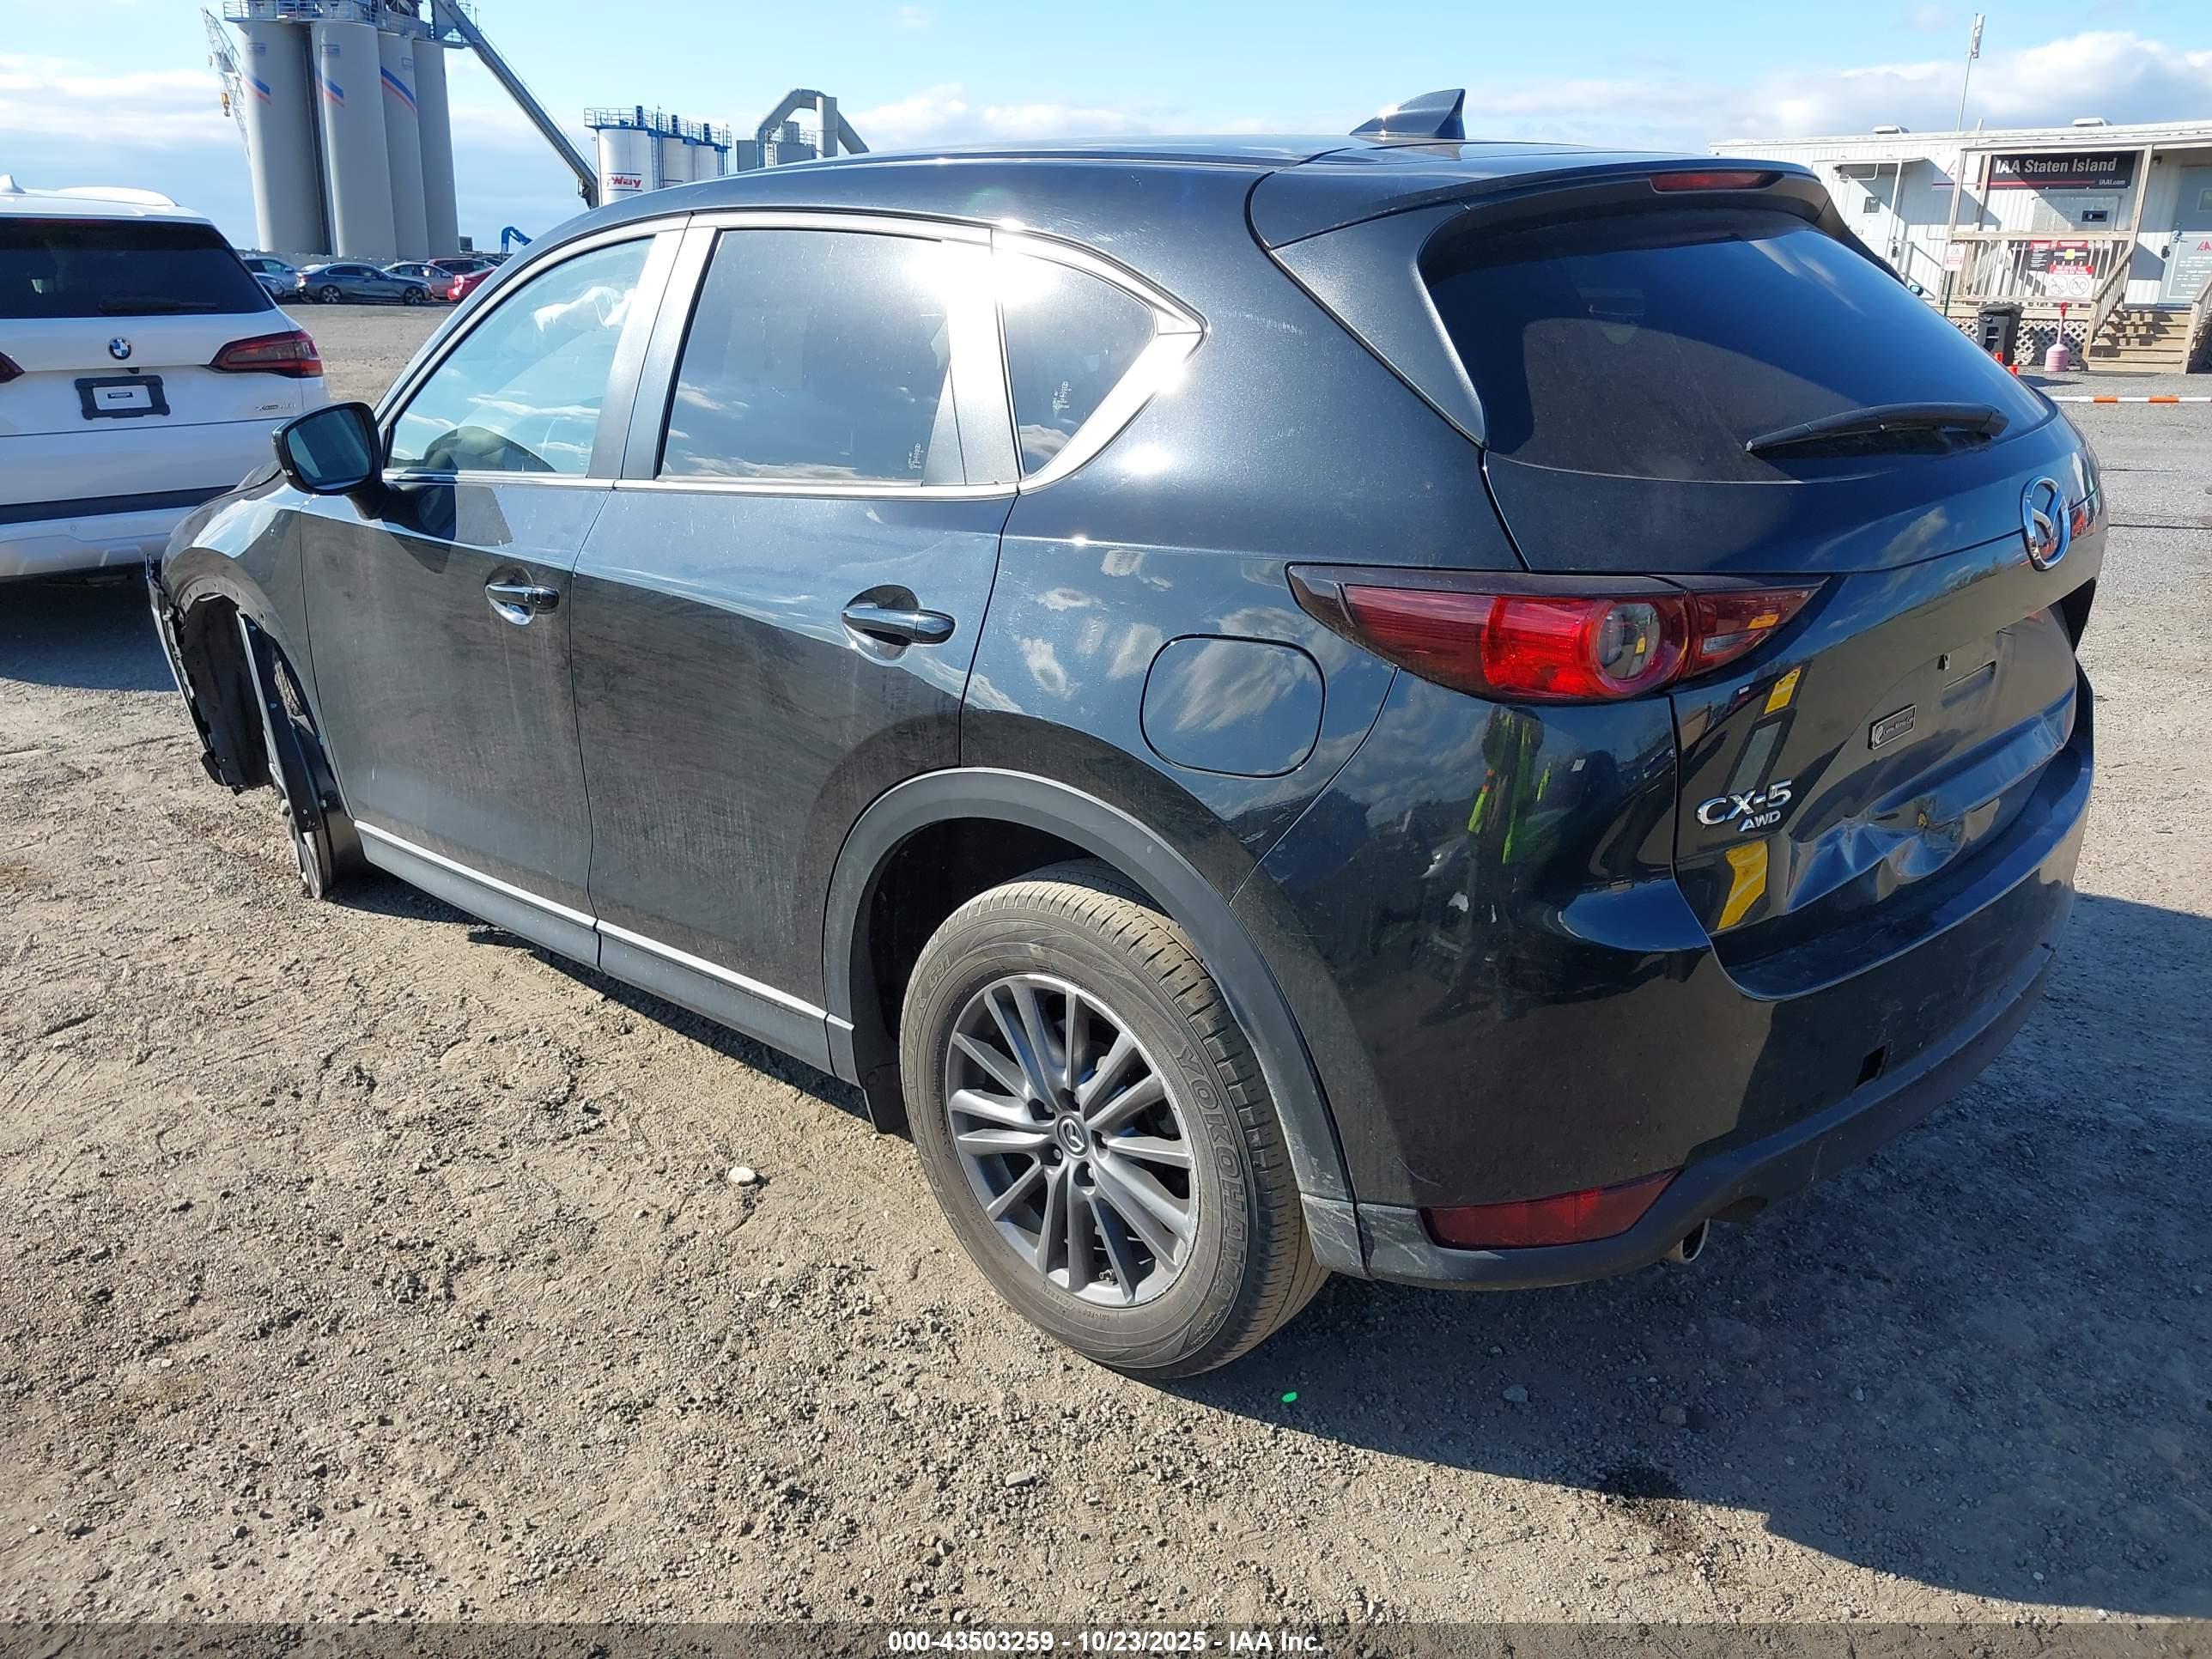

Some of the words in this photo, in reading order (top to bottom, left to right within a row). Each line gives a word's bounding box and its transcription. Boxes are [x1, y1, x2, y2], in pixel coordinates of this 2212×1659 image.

[1995, 160, 2021, 174] IAA
[2024, 159, 2069, 173] Staten
[2072, 157, 2118, 173] Island
[1696, 779, 1793, 826] CX-5
[1737, 810, 1781, 832] AWD
[1176, 1044, 1246, 1302] YOKOHAMA
